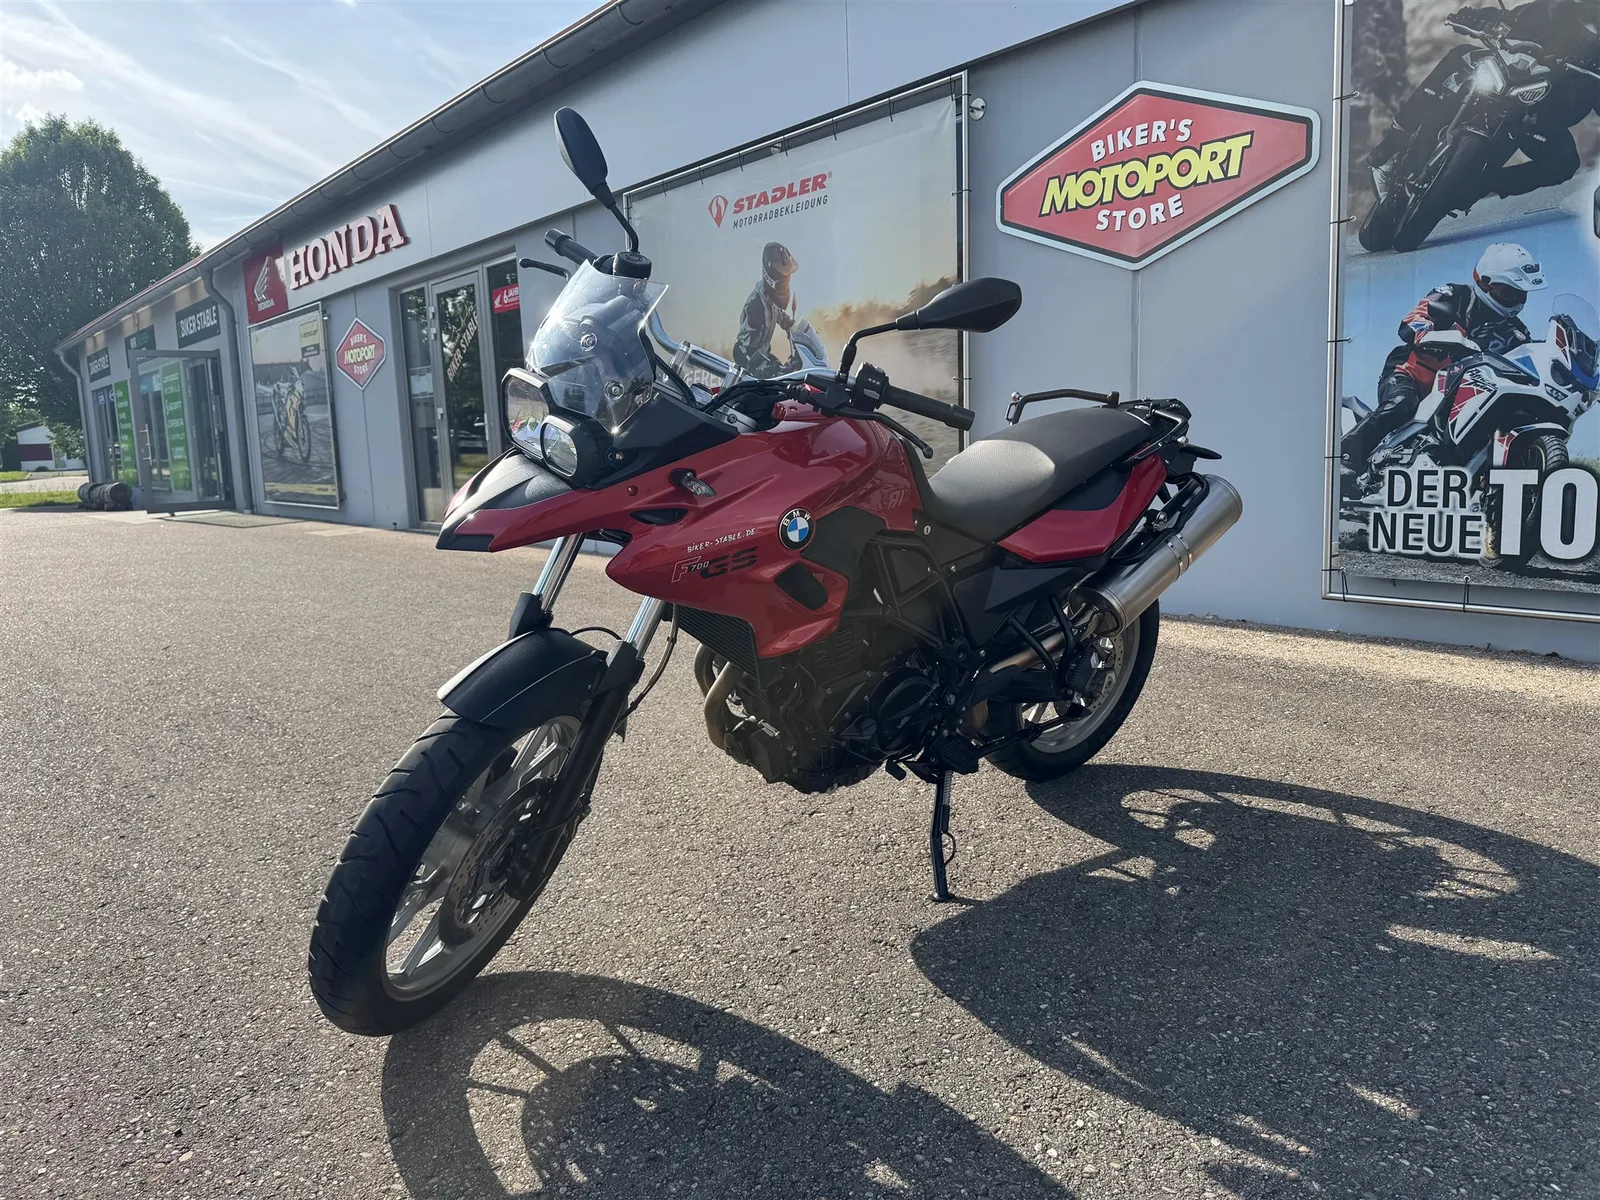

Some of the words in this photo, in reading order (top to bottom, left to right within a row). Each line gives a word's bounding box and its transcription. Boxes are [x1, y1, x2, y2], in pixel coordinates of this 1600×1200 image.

[1090, 118, 1193, 162] BIKER'S
[1038, 130, 1254, 217] MOTOPORT
[733, 195, 828, 229] MOTORRADBEKLEIDUNG
[1096, 194, 1184, 231] STORE
[287, 204, 406, 290] HONDA
[257, 299, 275, 312] HONDA
[503, 290, 509, 304] 6
[180, 314, 197, 338] BIKER
[196, 305, 218, 331] STABLE
[344, 344, 376, 365] MOTOPORT
[350, 333, 367, 346] BIKER'S
[447, 348, 463, 381] BIKER
[460, 310, 478, 354] STABLE
[353, 363, 369, 375] STORE
[1387, 469, 1469, 508] DER
[782, 510, 811, 526] BMW
[1489, 468, 1599, 560] TO
[1372, 512, 1482, 554] NEUE
